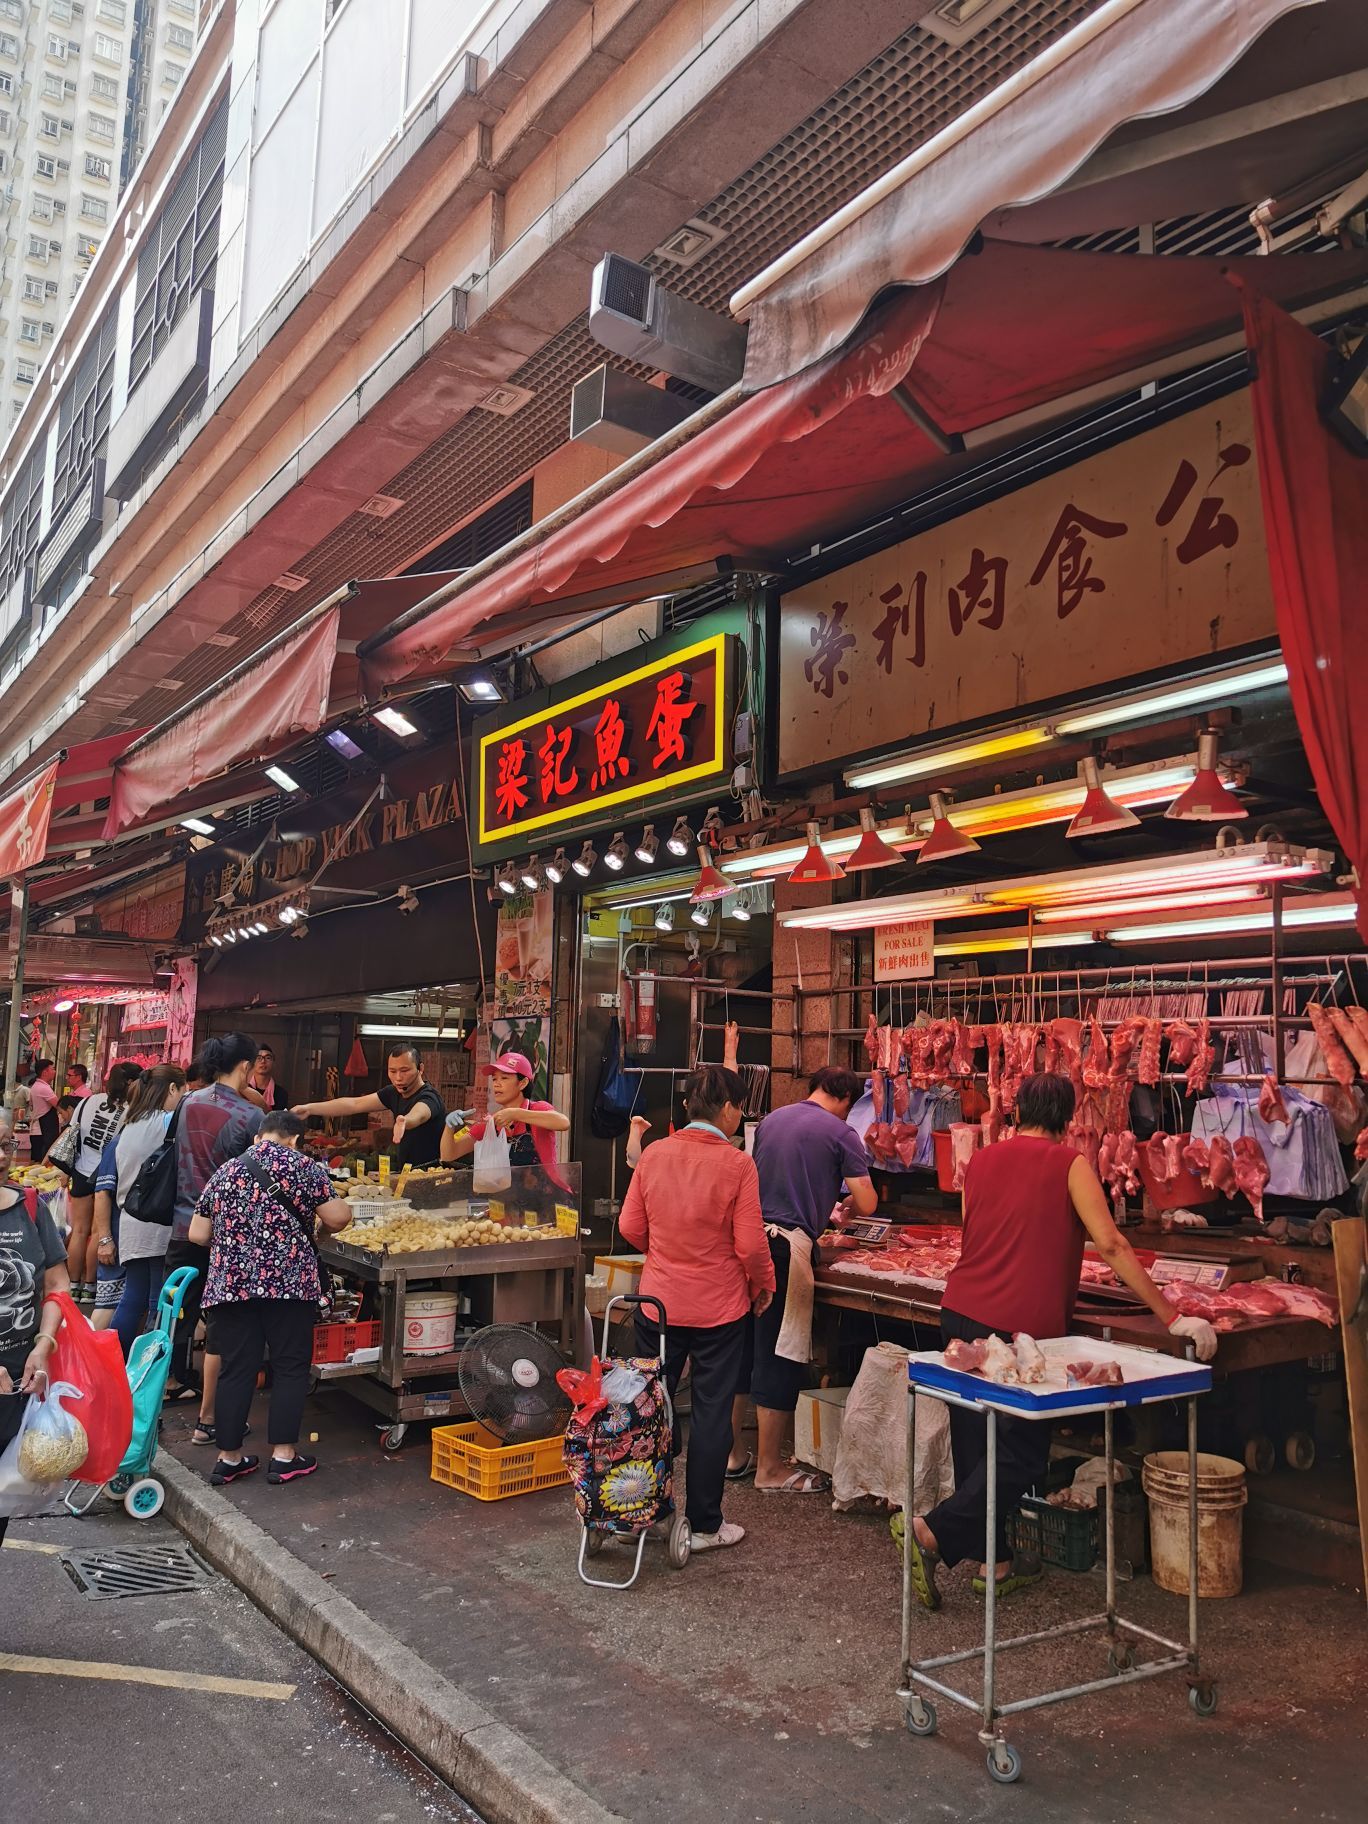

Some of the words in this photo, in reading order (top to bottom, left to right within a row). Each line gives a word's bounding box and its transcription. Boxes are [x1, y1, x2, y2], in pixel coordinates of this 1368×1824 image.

[496, 671, 697, 820] 梁記魚蛋
[275, 838, 317, 882] HOP
[320, 815, 373, 862] YICK
[381, 779, 463, 845] PLAZA
[879, 951, 929, 971] 新鮮肉出售
[884, 940, 900, 951] FOR
[902, 937, 923, 948] SALE
